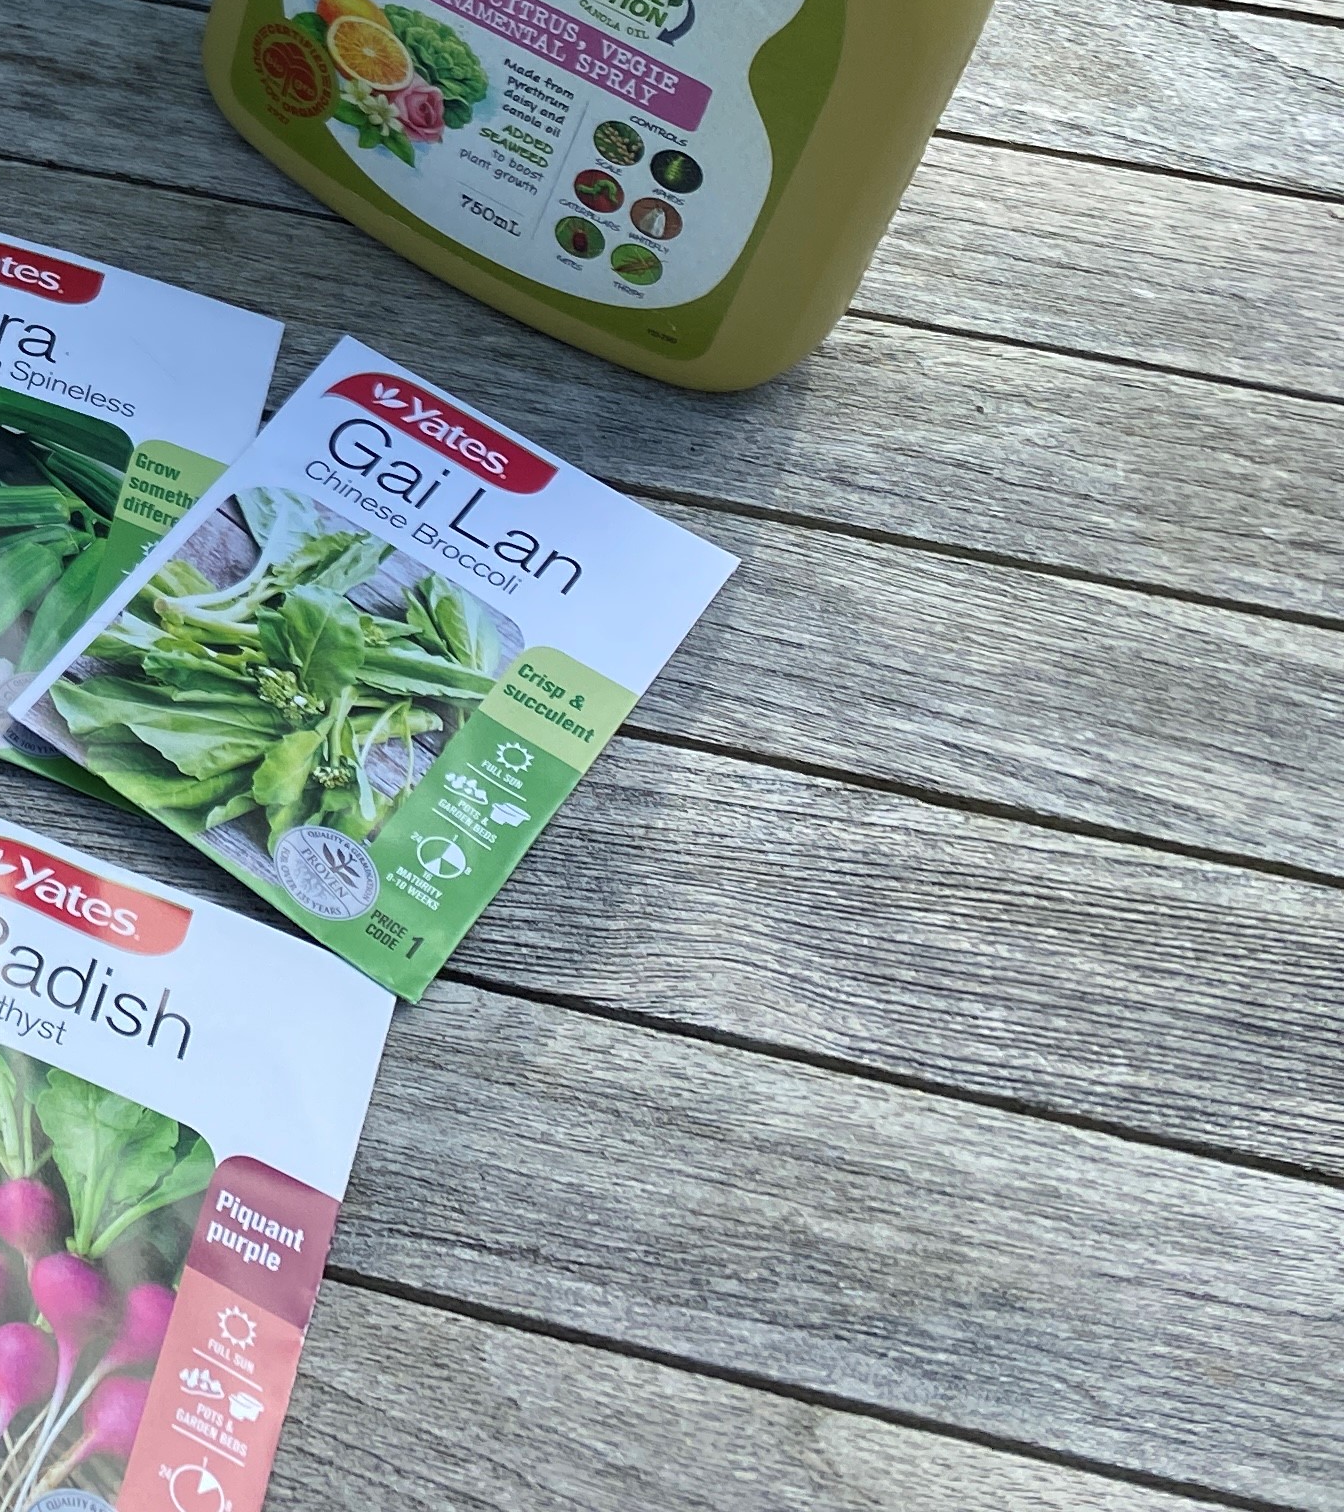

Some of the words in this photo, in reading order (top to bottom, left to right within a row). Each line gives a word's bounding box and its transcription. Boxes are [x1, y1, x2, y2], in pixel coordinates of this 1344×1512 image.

[504, 58, 541, 83] Made
[543, 78, 575, 100] from
[575, 55, 660, 108] SPRAY
[600, 41, 680, 95] VEGIE
[504, 89, 538, 115] daisy
[539, 106, 566, 125] and
[507, 75, 570, 113] pyrethrum
[502, 103, 541, 129] canola
[544, 122, 561, 138] oil
[502, 124, 554, 155] ADDED
[630, 115, 689, 147] CONTROLS
[479, 127, 549, 169] SEAWEED
[461, 194, 522, 237] 750mL
[9, 360, 136, 418] Spineless
[400, 396, 509, 475] Yates
[135, 453, 181, 481] Grow
[304, 459, 408, 530] Chinese
[411, 521, 524, 596] Broccoli
[328, 418, 452, 510] Gai
[448, 487, 584, 596] Lan
[517, 663, 566, 701] Crisp
[569, 693, 585, 712] &
[503, 683, 597, 743] succulent
[14, 855, 140, 938] Yates
[206, 1220, 282, 1272] purple
[215, 1189, 305, 1253] Piquant
